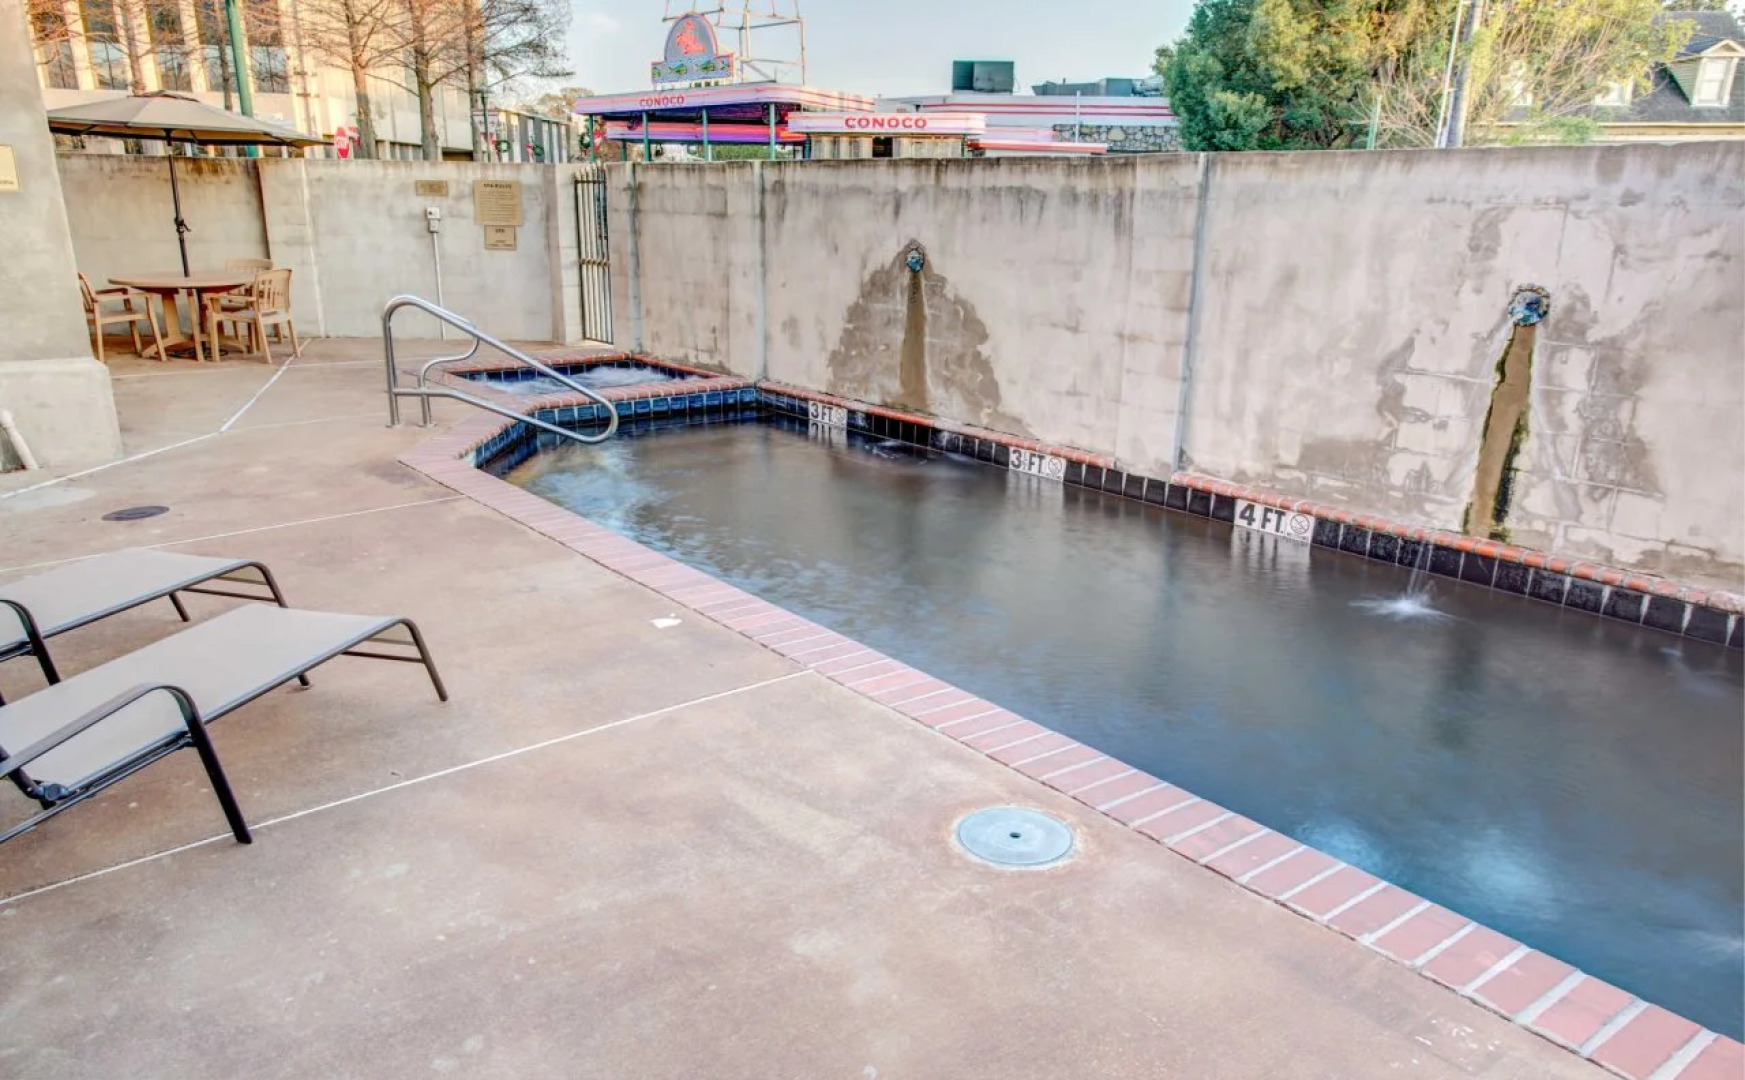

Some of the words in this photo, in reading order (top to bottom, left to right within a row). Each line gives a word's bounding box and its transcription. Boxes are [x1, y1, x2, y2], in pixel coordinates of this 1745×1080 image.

[640, 94, 685, 107] CONOCO
[844, 116, 928, 129] CONOCO
[810, 402, 819, 419] 3
[1238, 502, 1256, 526] 4
[1260, 506, 1287, 534] FT.
